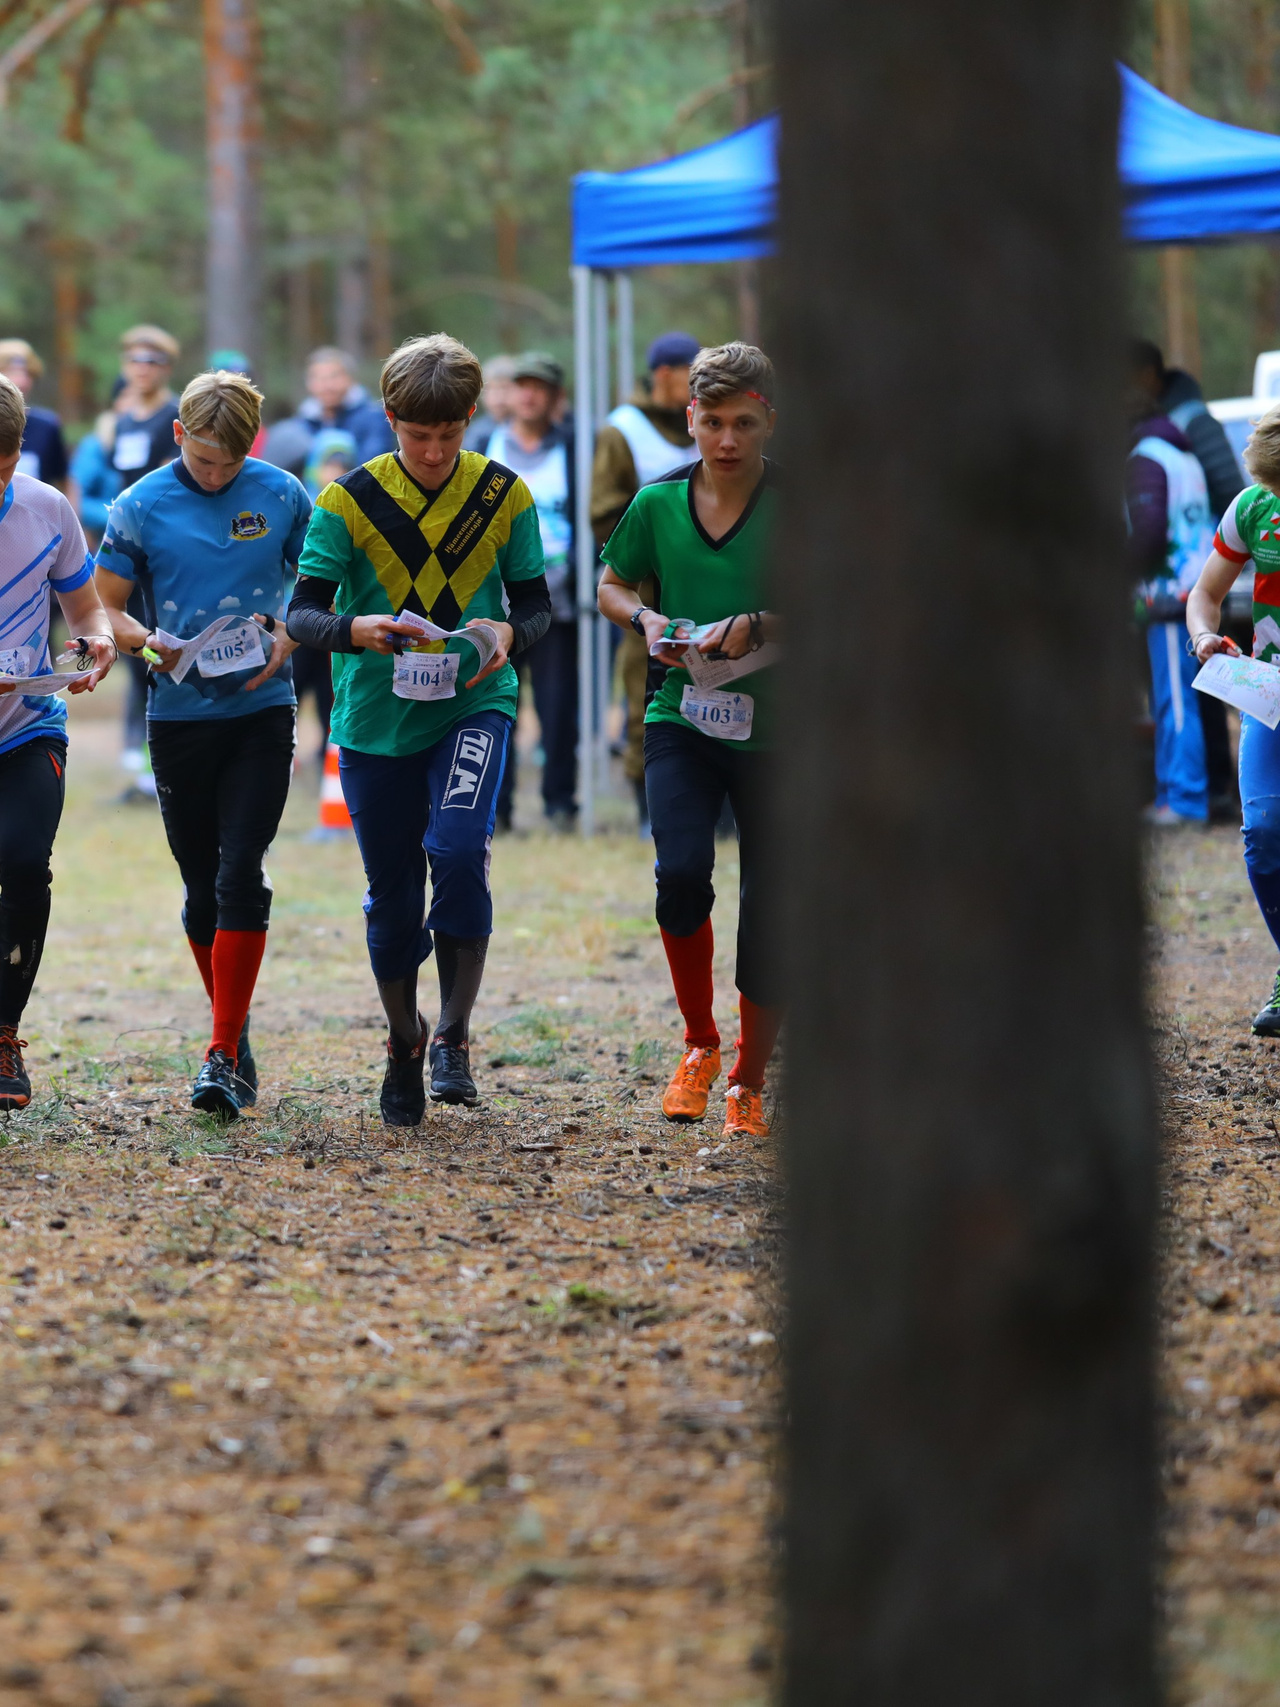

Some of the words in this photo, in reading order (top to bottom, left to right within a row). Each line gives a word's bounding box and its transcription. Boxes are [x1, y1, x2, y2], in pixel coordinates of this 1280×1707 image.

[452, 516, 484, 555] Suunnistajat
[215, 640, 245, 661] 105
[412, 669, 440, 687] 104
[701, 705, 731, 724] 103
